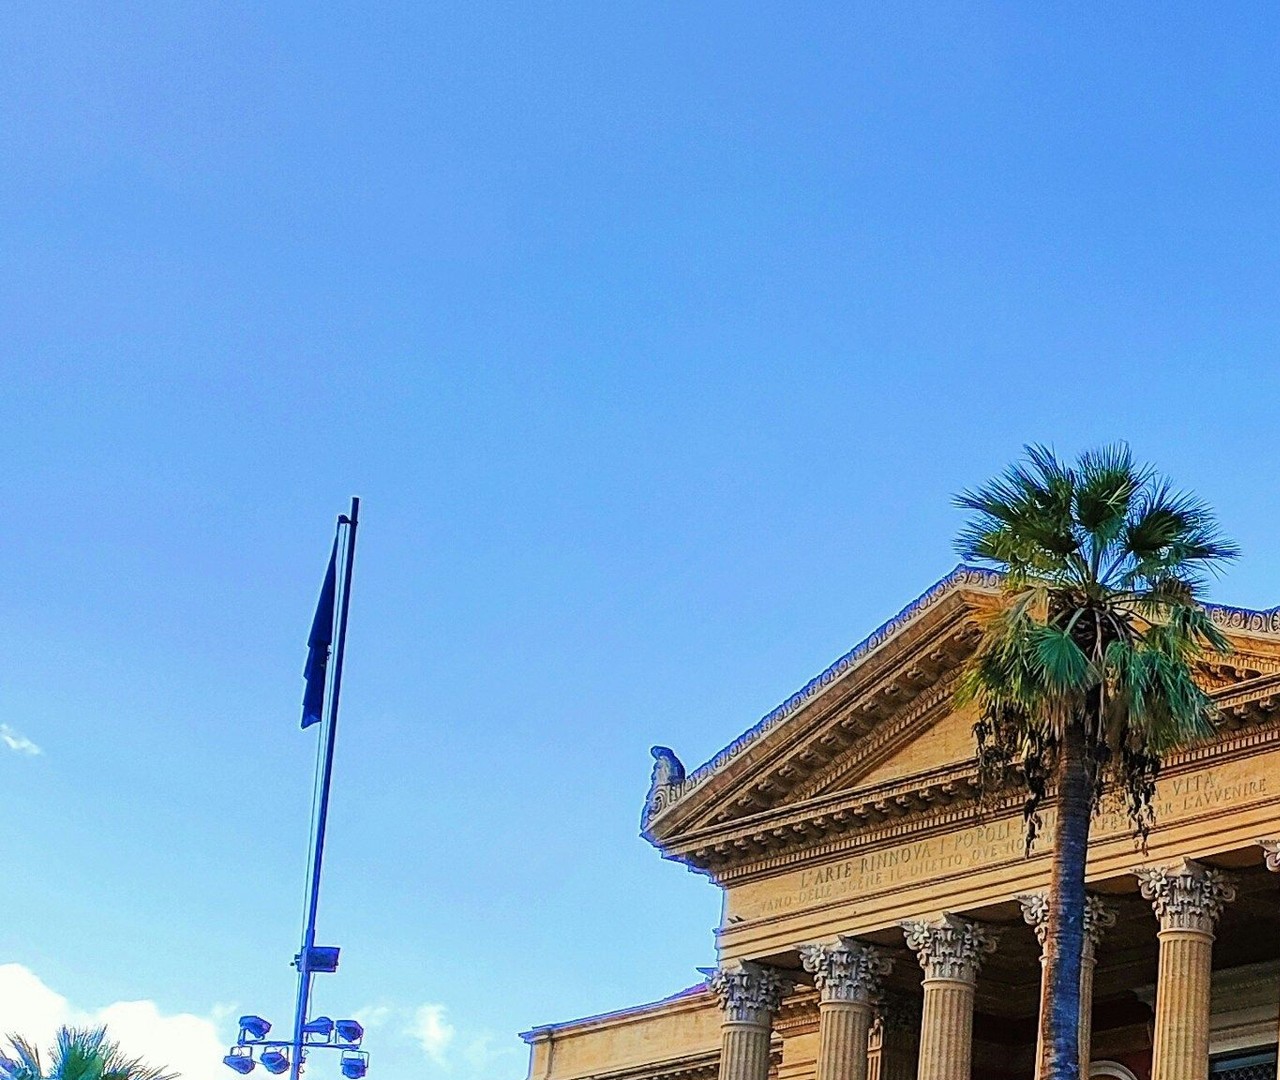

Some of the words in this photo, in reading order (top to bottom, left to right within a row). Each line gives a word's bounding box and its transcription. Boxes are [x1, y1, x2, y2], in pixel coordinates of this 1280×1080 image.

[1184, 778, 1267, 811] L'AVVENIRE
[801, 861, 852, 889] L'ARTE
[860, 844, 931, 874] RINNOVA
[954, 821, 1011, 851] POPOLI
